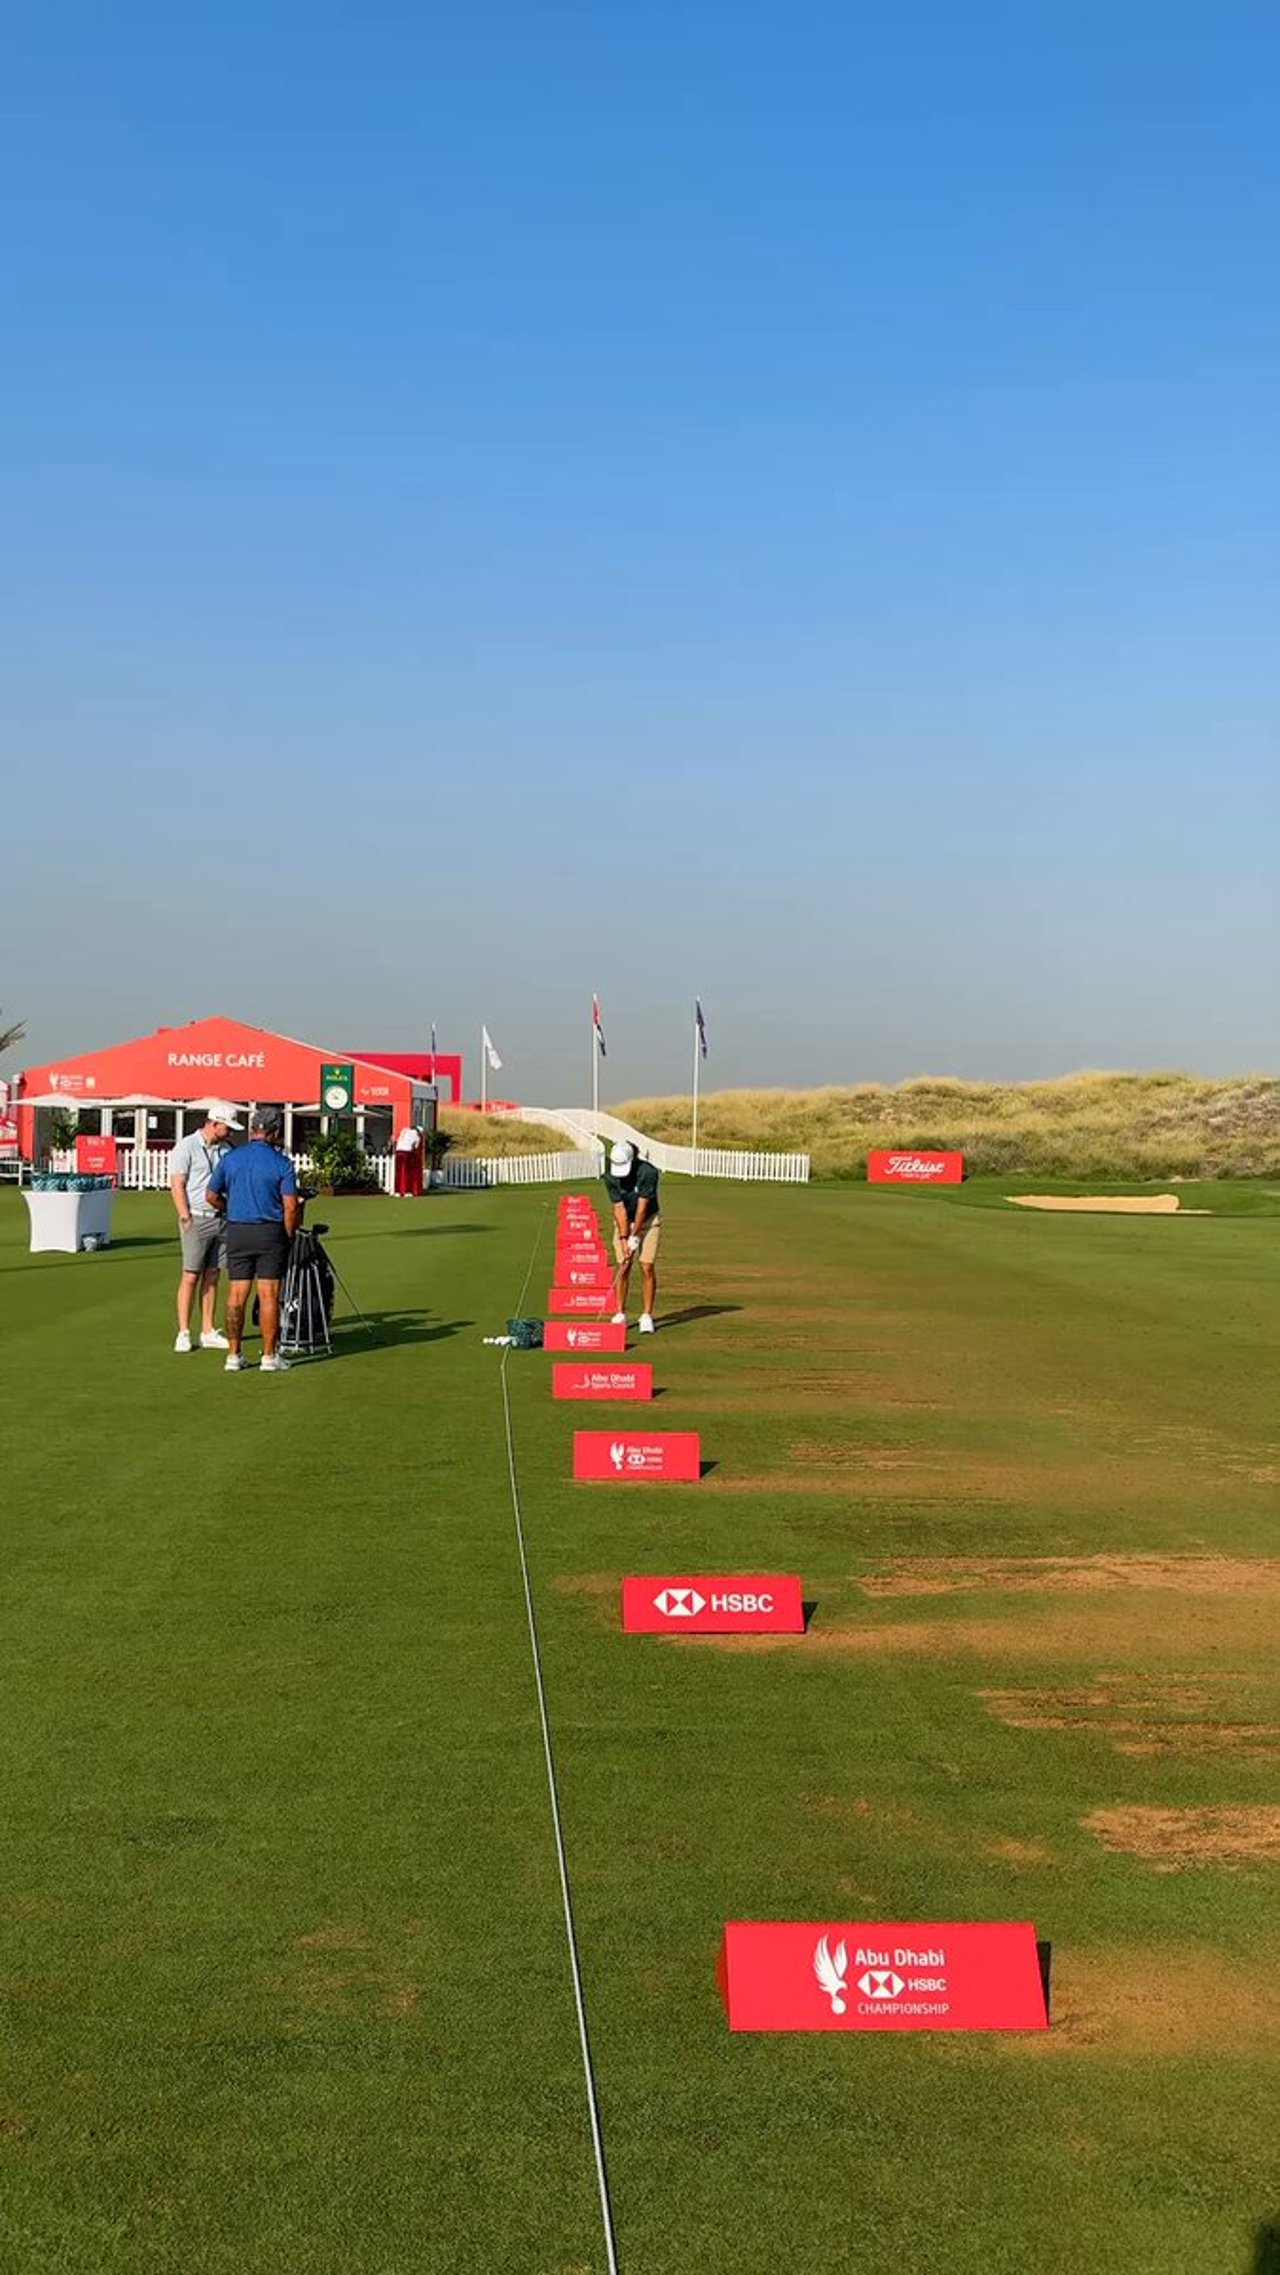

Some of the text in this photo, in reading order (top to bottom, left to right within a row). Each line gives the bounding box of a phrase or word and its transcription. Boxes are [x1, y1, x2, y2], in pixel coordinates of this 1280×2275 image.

[167, 1052, 265, 1068] RANGE CAFÉ
[884, 1156, 945, 1175] Titleist
[711, 1594, 774, 1612] HSBC
[855, 1948, 945, 1966] Abu Dhabi
[908, 1979, 947, 1992] HSBC
[857, 2003, 949, 2014] CHAMPIONSHIP
